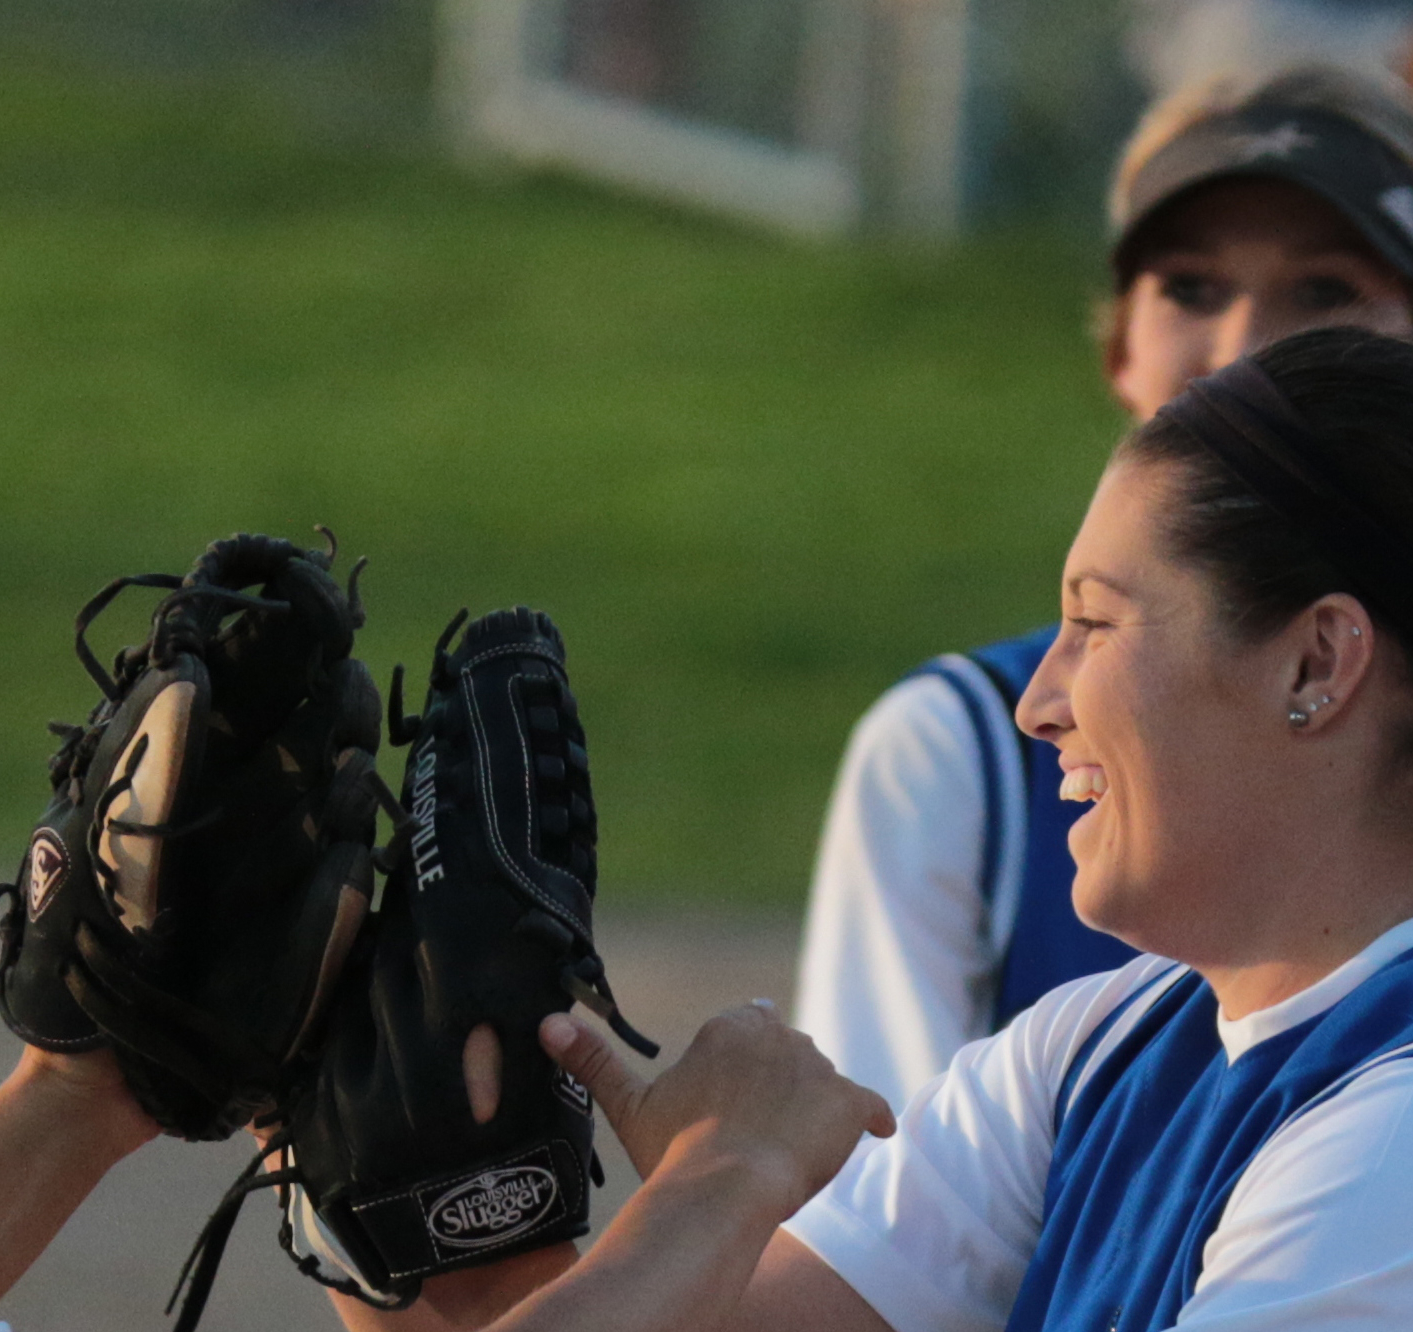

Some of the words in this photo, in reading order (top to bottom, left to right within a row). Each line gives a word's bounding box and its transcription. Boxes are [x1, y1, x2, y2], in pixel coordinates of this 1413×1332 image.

[411, 734, 445, 892] LOUISVILLE
[442, 1182, 544, 1235] Slugger
[464, 1174, 538, 1209] LOUISVILLE
